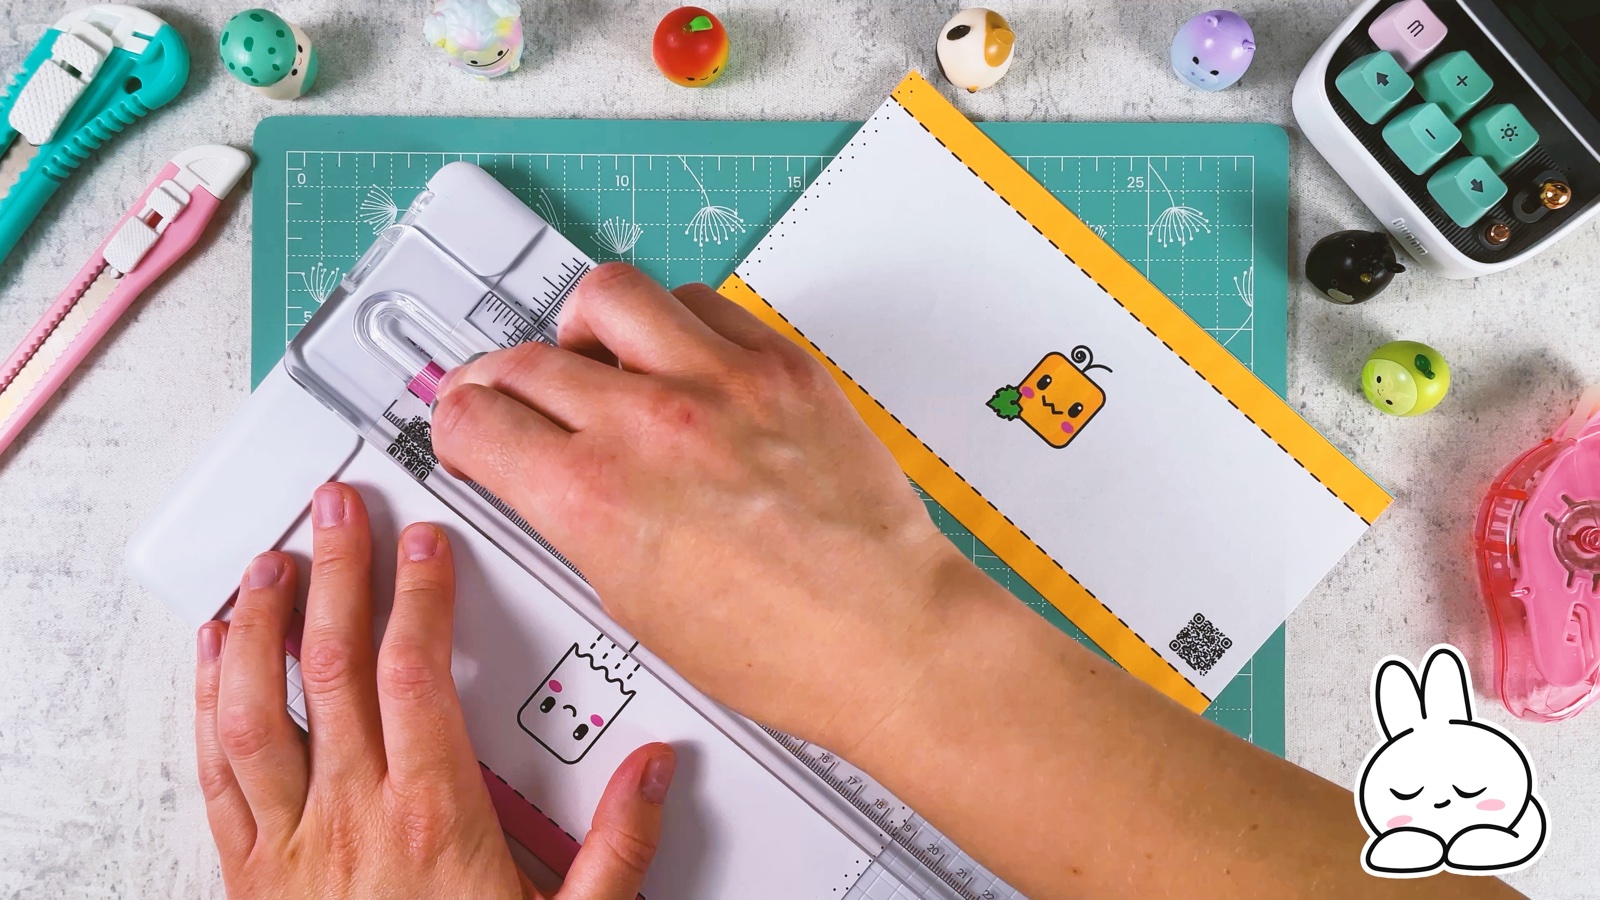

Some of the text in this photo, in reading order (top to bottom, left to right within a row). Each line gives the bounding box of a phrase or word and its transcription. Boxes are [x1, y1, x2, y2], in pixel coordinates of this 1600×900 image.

[297, 172, 1145, 189] 0 10 15 25
[303, 310, 313, 323] 5
[819, 752, 830, 764] 16
[847, 775, 858, 785] 17
[873, 798, 885, 810] 18
[901, 821, 912, 833] 19
[926, 843, 940, 856] 20
[956, 868, 968, 880] 21
